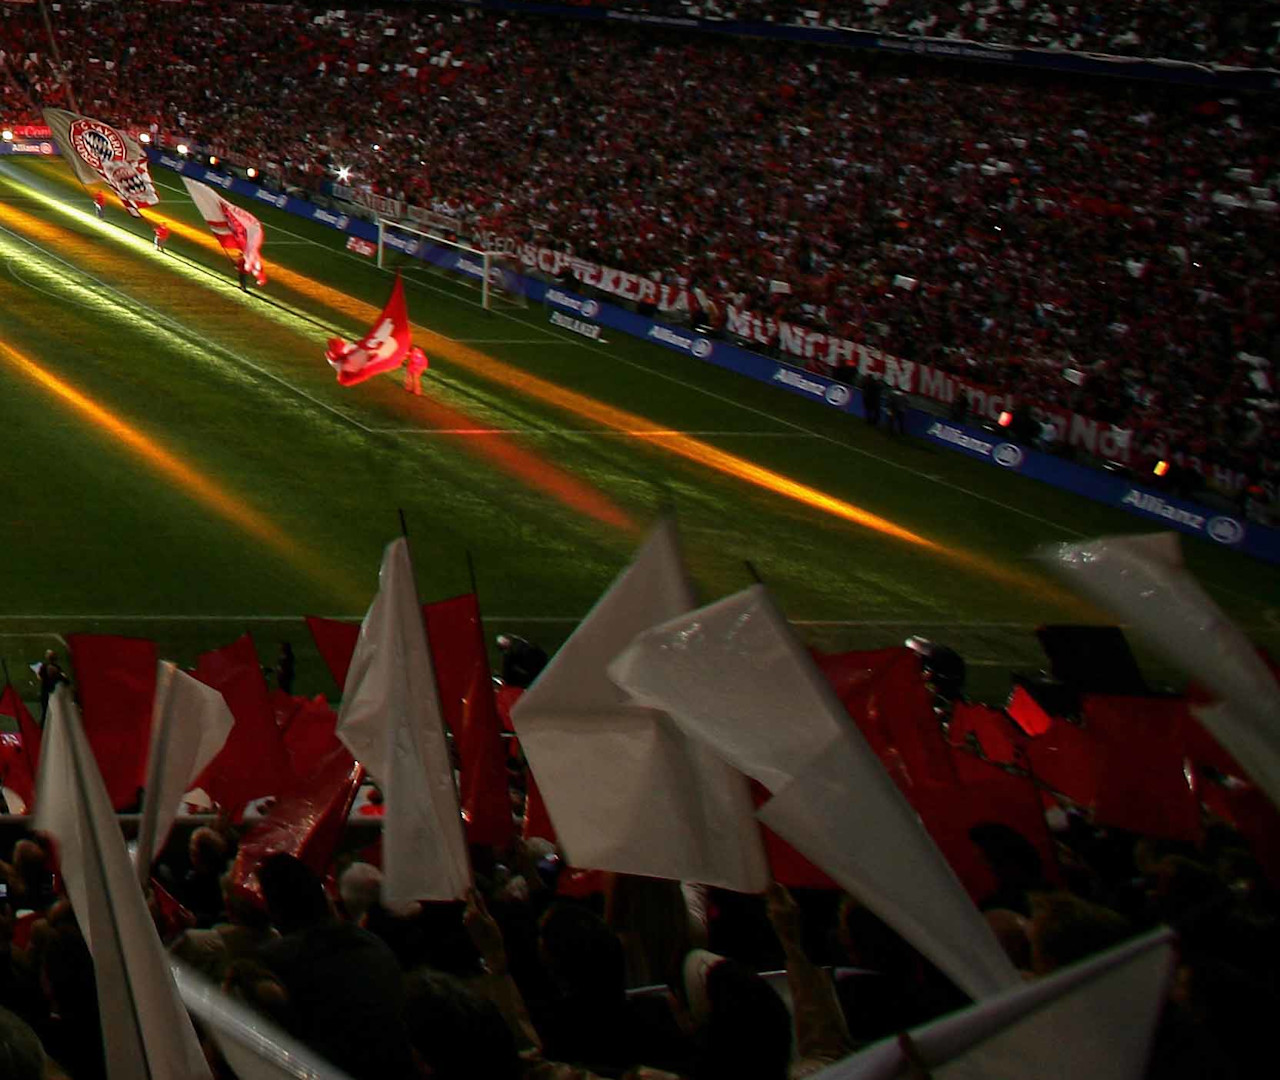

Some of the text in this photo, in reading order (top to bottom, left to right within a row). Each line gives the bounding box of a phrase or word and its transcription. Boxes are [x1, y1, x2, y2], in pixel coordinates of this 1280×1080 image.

[647, 324, 692, 350] Allianz
[772, 367, 826, 397] Allianz
[927, 421, 993, 456] Allianz
[1120, 488, 1207, 531] Allianz
